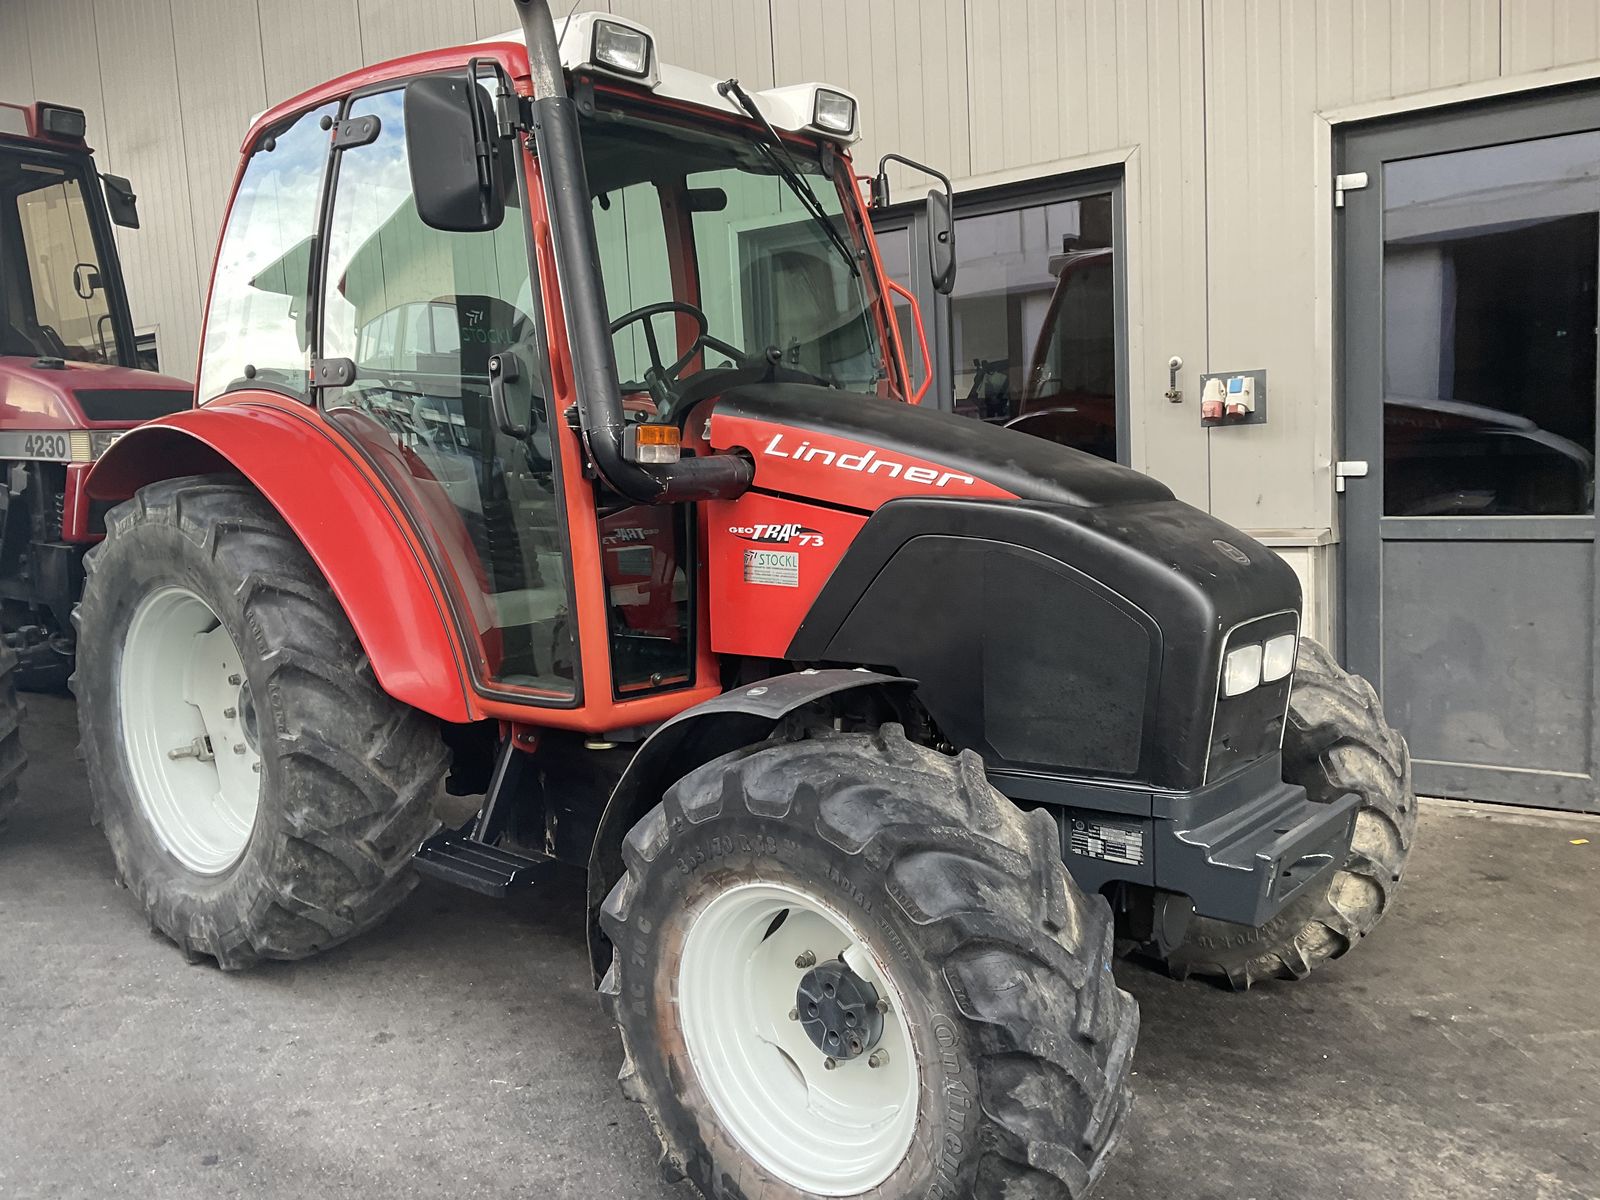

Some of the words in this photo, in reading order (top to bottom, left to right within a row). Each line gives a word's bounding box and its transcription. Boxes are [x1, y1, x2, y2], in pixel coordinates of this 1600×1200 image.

[24, 434, 66, 458] 4230
[764, 433, 975, 488] Lindner
[798, 535, 825, 547] 73
[758, 553, 798, 568] STOCKL
